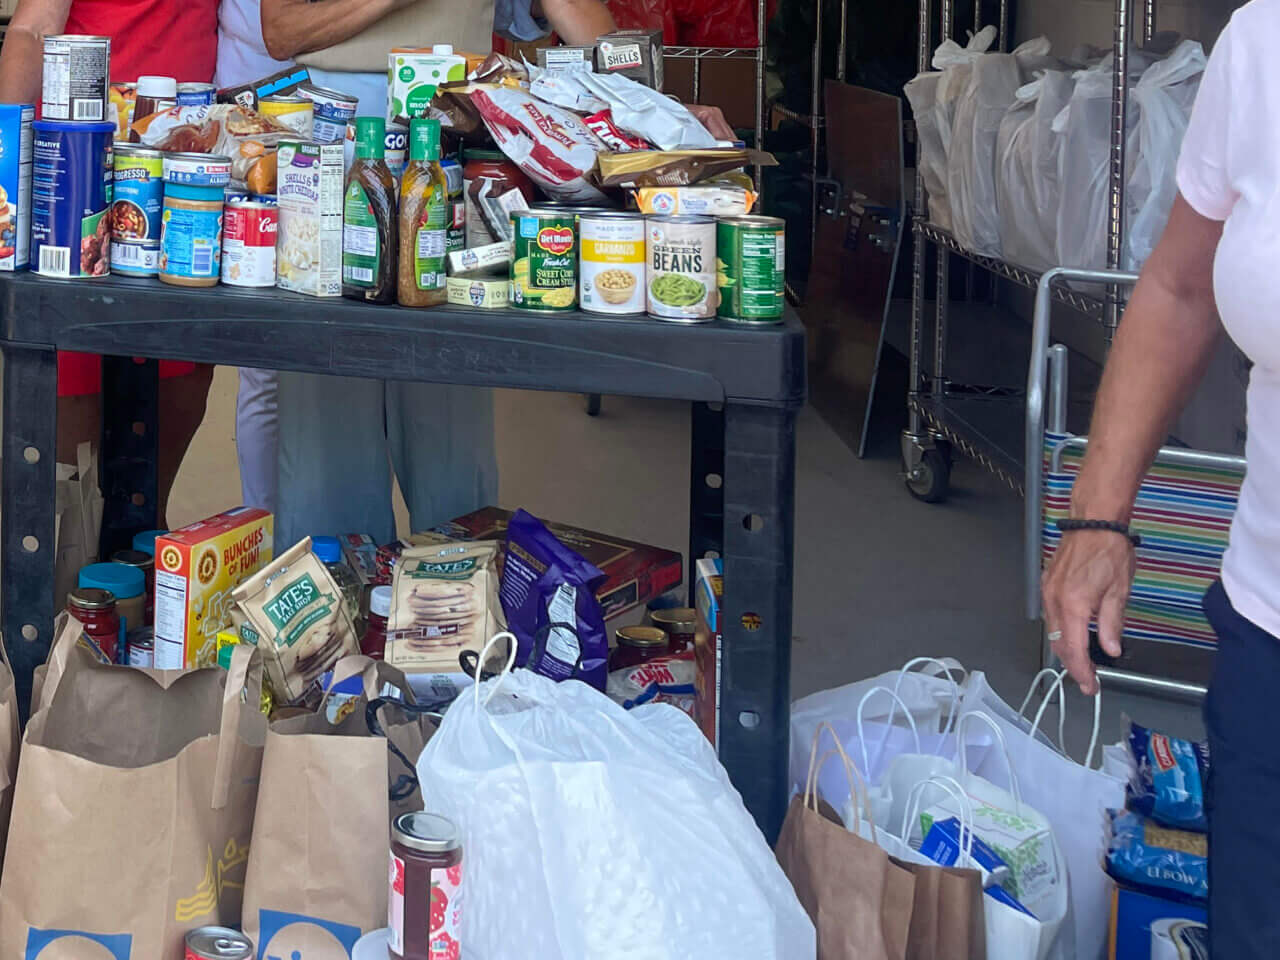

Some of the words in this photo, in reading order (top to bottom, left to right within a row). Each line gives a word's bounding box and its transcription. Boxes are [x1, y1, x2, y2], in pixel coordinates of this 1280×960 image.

[608, 51, 639, 65] SHELLS
[653, 245, 703, 254] GREEN
[653, 252, 703, 273] BEANS
[536, 269, 559, 278] SWEET
[536, 278, 560, 287] CREAM
[223, 527, 264, 566] BUNCHES
[268, 579, 313, 620] TATE'S
[1147, 866, 1198, 886] ELBOW
